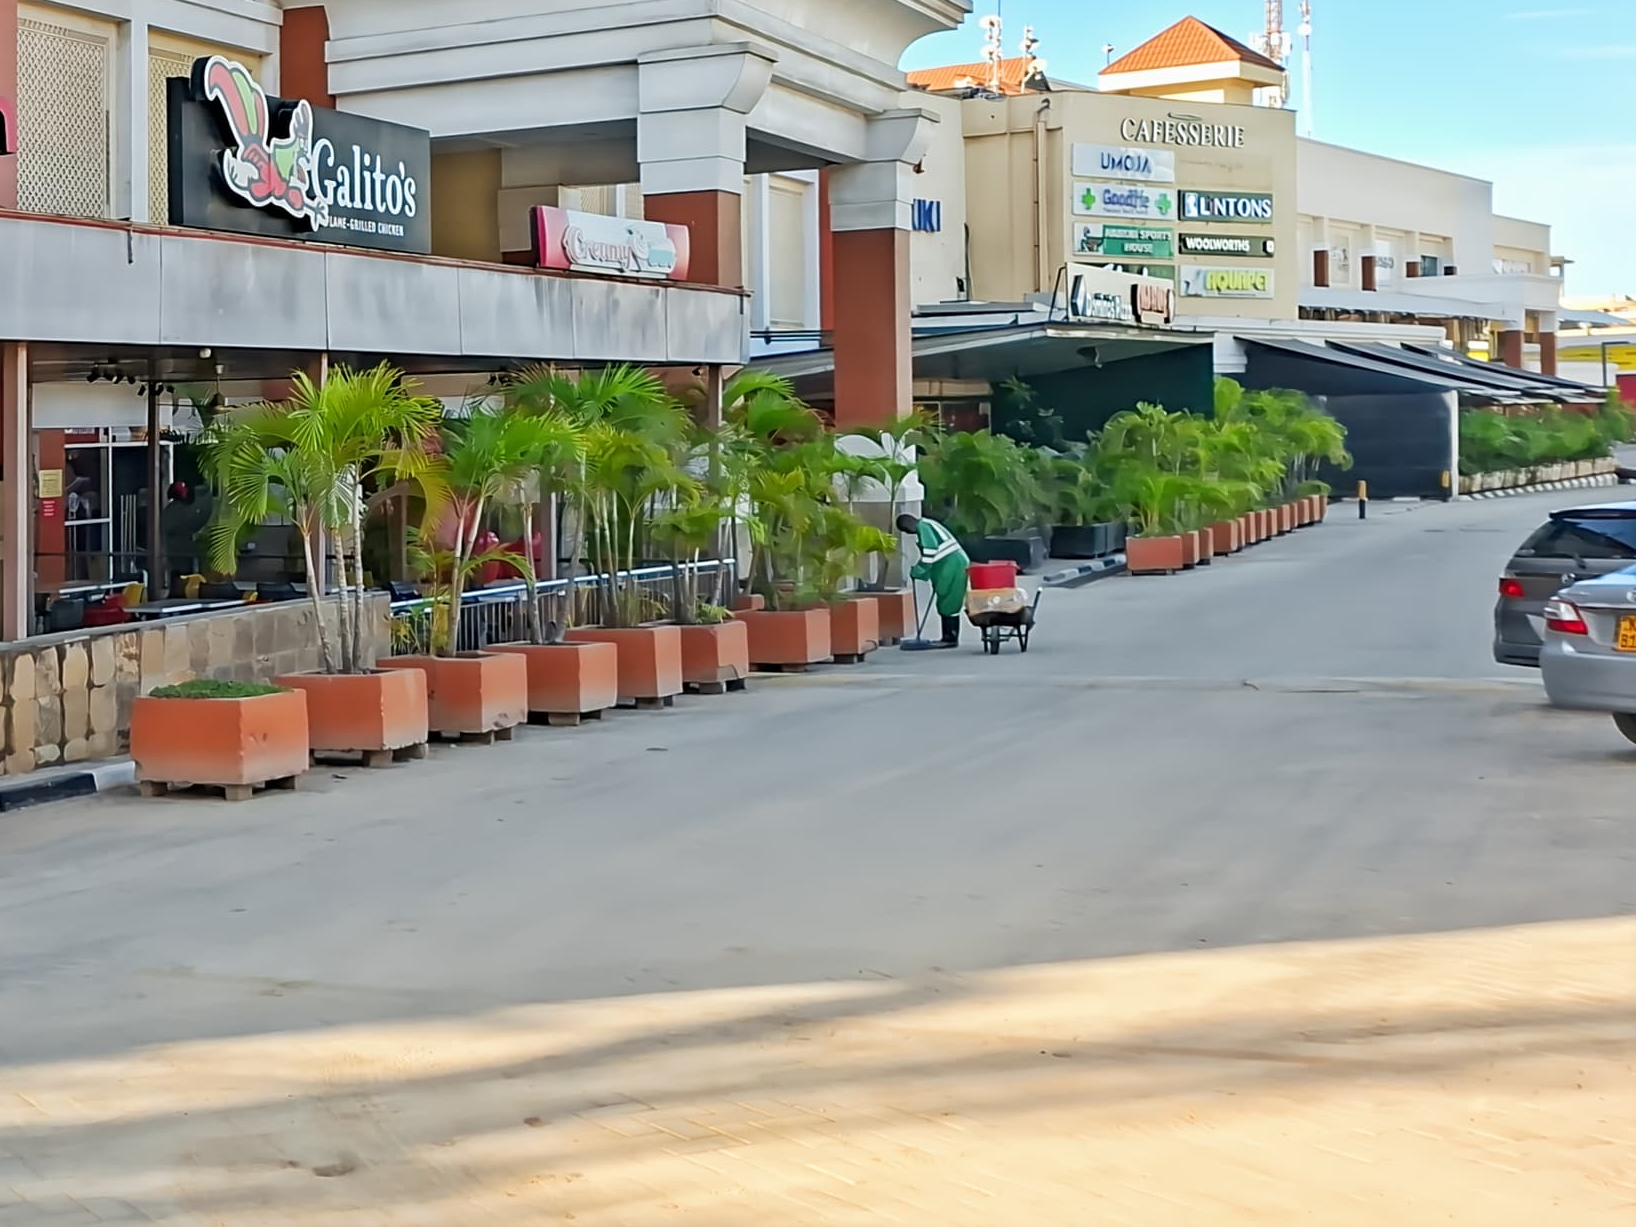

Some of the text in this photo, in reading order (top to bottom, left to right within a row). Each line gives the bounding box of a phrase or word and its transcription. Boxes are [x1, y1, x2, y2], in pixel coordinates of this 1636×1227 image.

[1121, 117, 1245, 149] CAFESSERIE
[311, 137, 416, 218] Galito's
[1183, 236, 1251, 252] WOOLWORTHS
